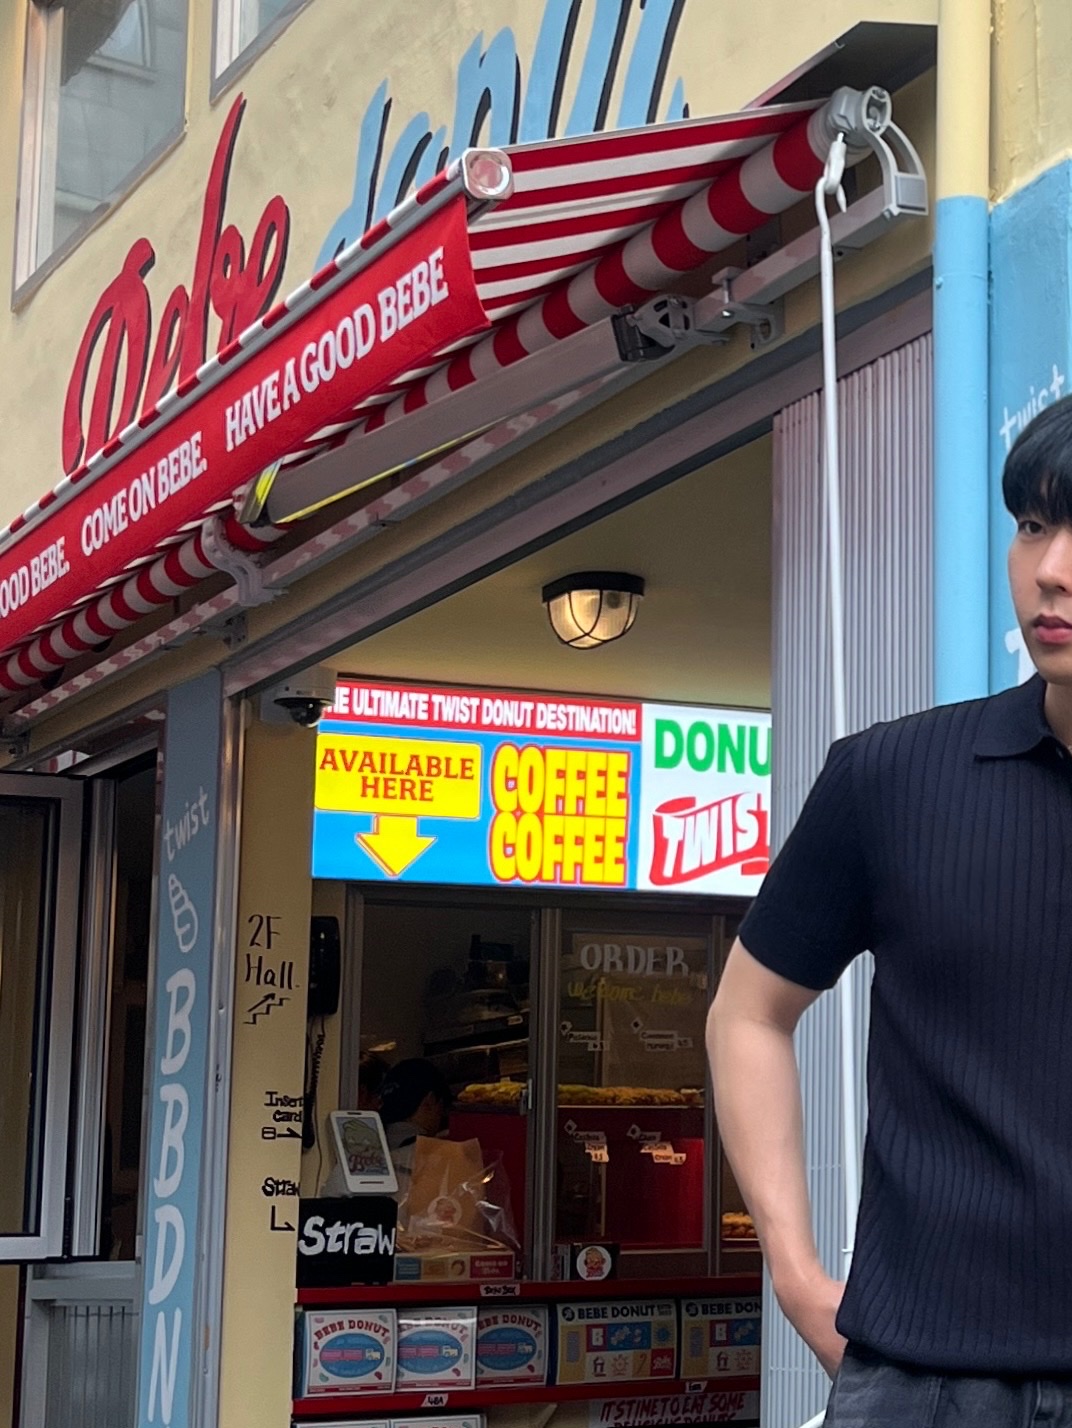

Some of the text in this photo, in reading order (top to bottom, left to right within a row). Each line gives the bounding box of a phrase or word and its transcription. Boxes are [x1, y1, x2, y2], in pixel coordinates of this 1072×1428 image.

[81, 486, 128, 556] COME
[128, 475, 155, 521] ON
[156, 431, 207, 507] BEBE.
[225, 380, 282, 451] HAVE
[282, 362, 300, 410] A
[300, 305, 376, 393] GOOD
[379, 246, 449, 343] BEBE
[353, 688, 429, 720] ULTIMATE
[431, 694, 480, 724] TWIST
[481, 699, 534, 728] DONUT
[536, 703, 637, 735] DESTINATION!
[319, 748, 474, 781] AVAILABLE
[493, 744, 629, 817] COFFEE
[360, 776, 434, 802] HERE
[164, 785, 210, 861] twist
[490, 811, 627, 884] COFFEE
[247, 914, 282, 950] 2F
[580, 943, 689, 976] ORDER
[298, 1216, 395, 1256] Straw
[502, 1314, 542, 1332] DONUT
[578, 1306, 608, 1319] BEBE
[611, 1304, 656, 1318] DONUT
[701, 1302, 732, 1315] BEBE
[314, 1319, 390, 1340] BEBE DONUT
[709, 1393, 745, 1413] SOME
